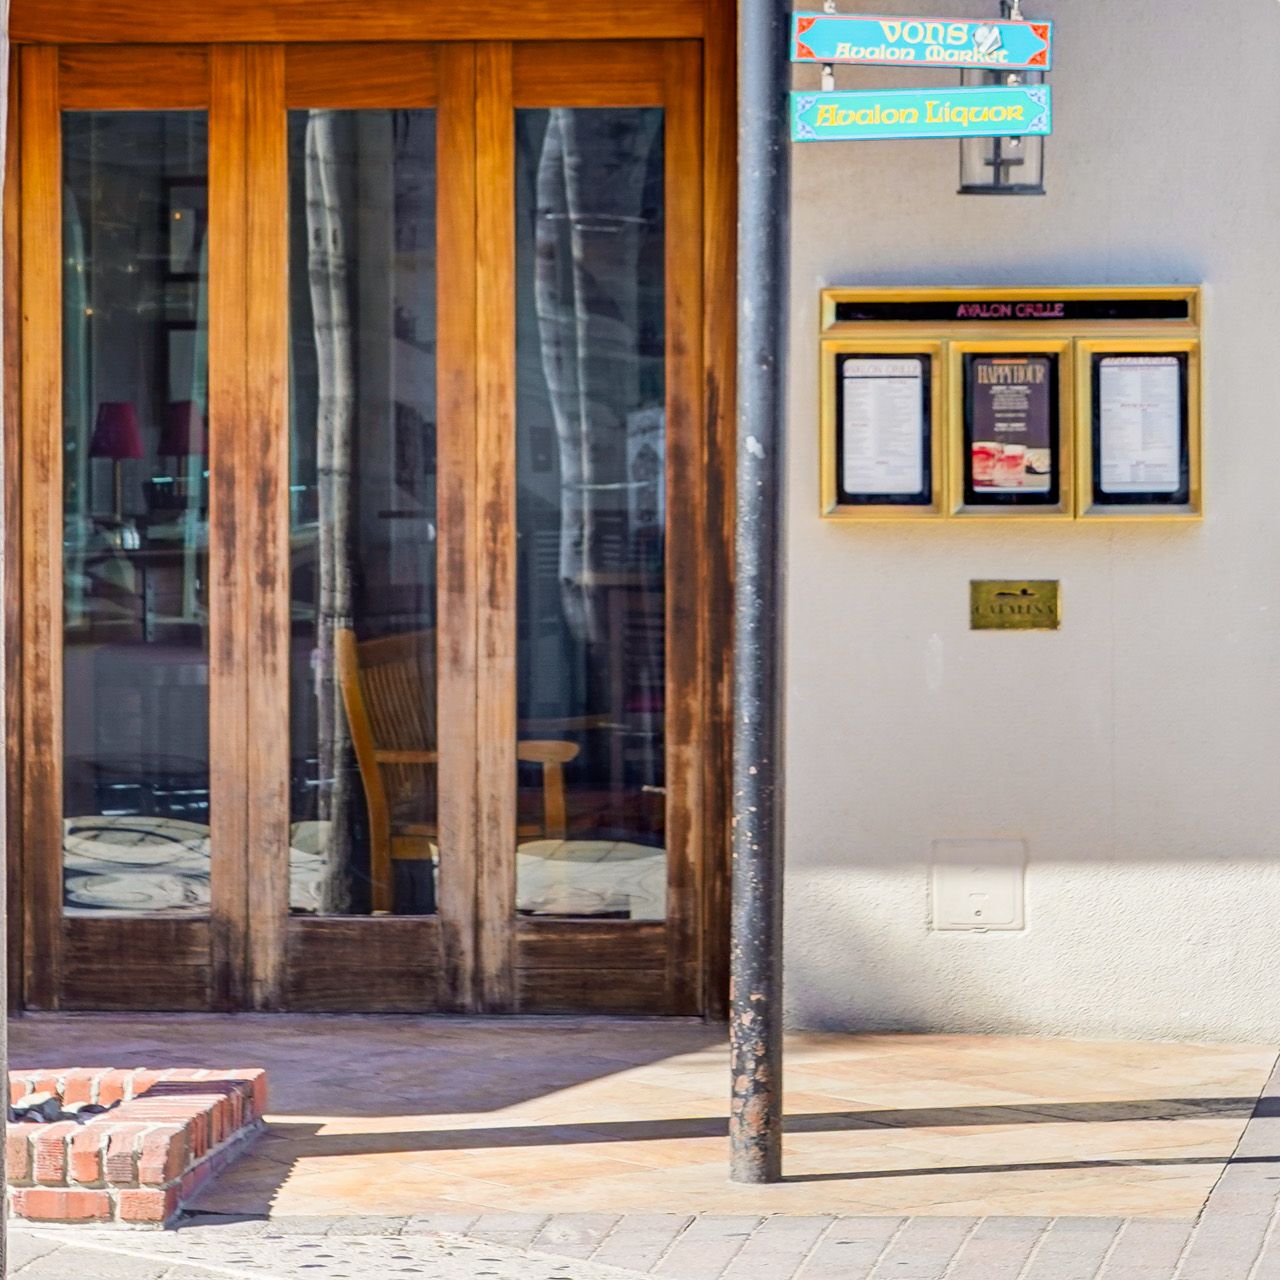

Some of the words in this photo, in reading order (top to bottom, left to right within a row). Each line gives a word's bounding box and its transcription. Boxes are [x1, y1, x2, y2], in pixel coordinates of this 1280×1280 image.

[834, 42, 915, 61] Avalon
[924, 43, 1009, 64] Market
[816, 104, 919, 127] Avalon
[925, 100, 1025, 127] Liquor
[956, 303, 1012, 318] AVALON
[1015, 303, 1065, 318] GRILLE
